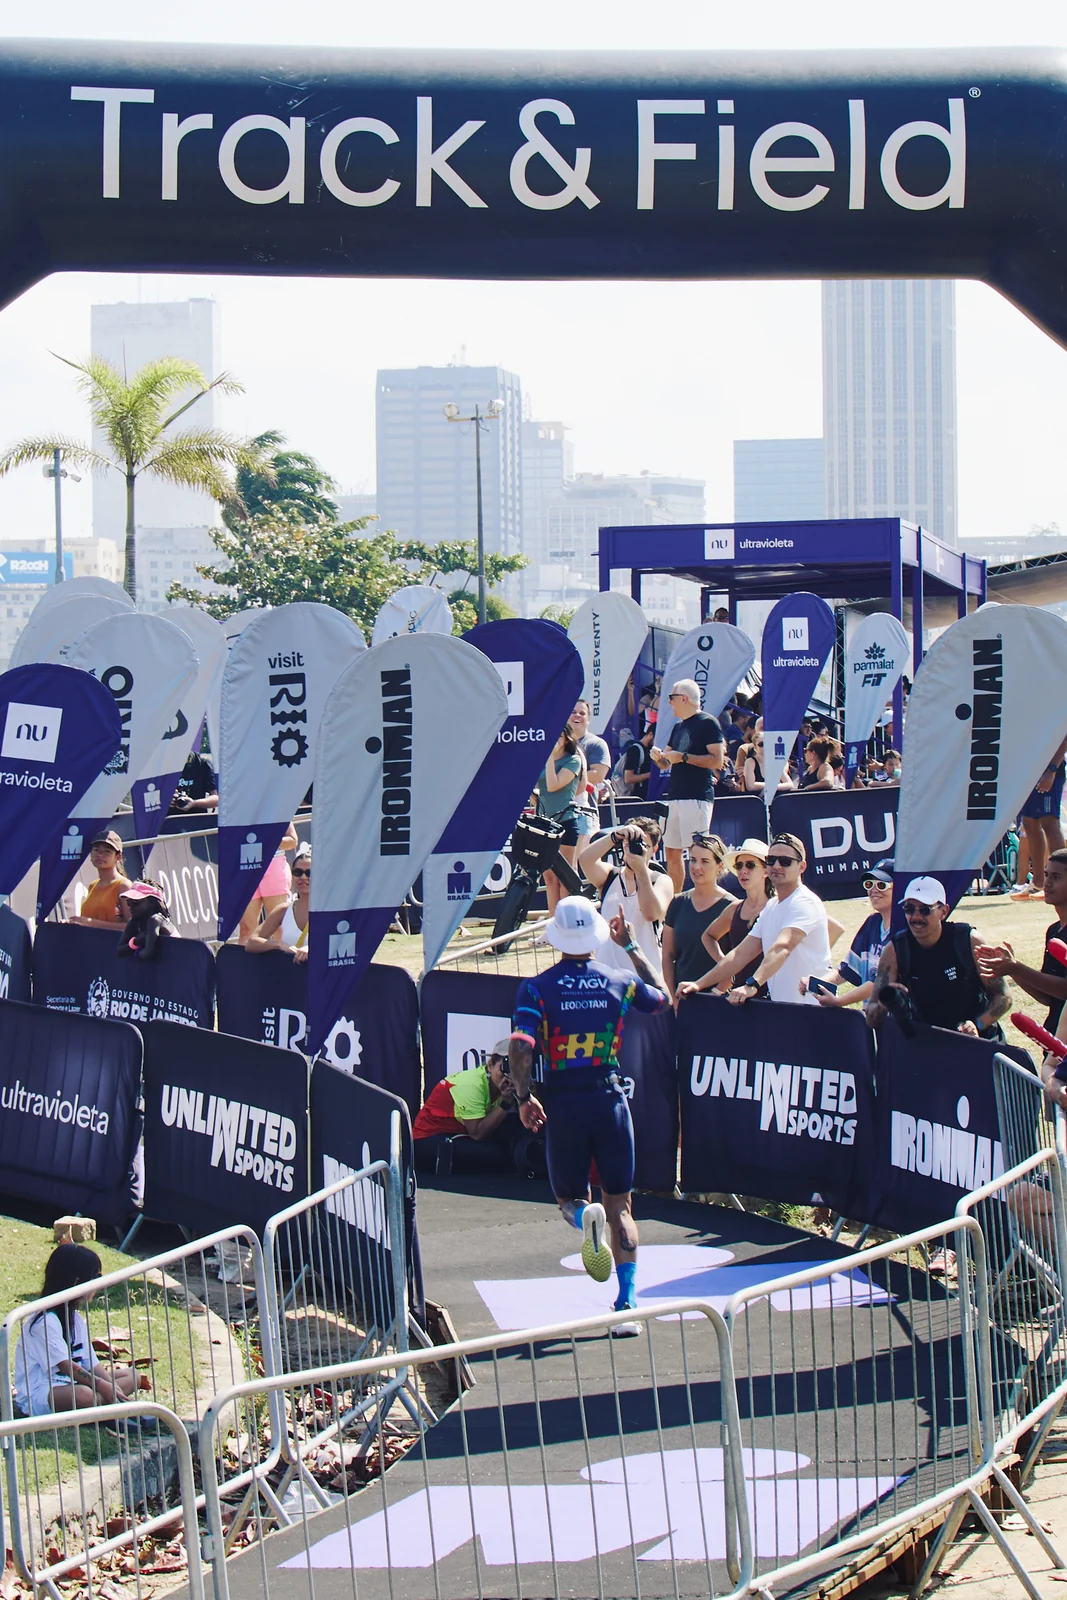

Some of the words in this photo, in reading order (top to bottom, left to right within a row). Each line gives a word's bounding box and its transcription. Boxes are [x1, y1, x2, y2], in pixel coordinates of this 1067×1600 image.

[70, 86, 488, 209] Track
[509, 97, 600, 211] &
[739, 538, 794, 550] ultravioleta
[267, 652, 305, 669] visit
[592, 612, 601, 677] SEVENTY
[773, 655, 820, 668] ultravioleta
[853, 659, 895, 674] parmalat
[593, 679, 601, 716] BLUE
[16, 723, 48, 742] nu
[955, 638, 1003, 821] IRONMAN
[365, 668, 413, 857] IRONMAN
[810, 812, 899, 859] DU
[239, 863, 262, 871] BRASIL
[816, 860, 870, 875] HUMAN
[328, 958, 356, 968] BRASIL
[110, 1000, 130, 1018] RIO
[130, 1003, 148, 1022] DE
[111, 988, 151, 1004] GOVERNO
[153, 997, 165, 1008] DO
[168, 1001, 199, 1019] ESTADO
[1, 1079, 110, 1136] ultravioleta
[690, 1055, 858, 1134] UNLIMITED
[160, 1084, 297, 1172] UNLIMITED
[787, 1109, 858, 1146] SPORTS
[233, 1148, 295, 1193] SPORTS
